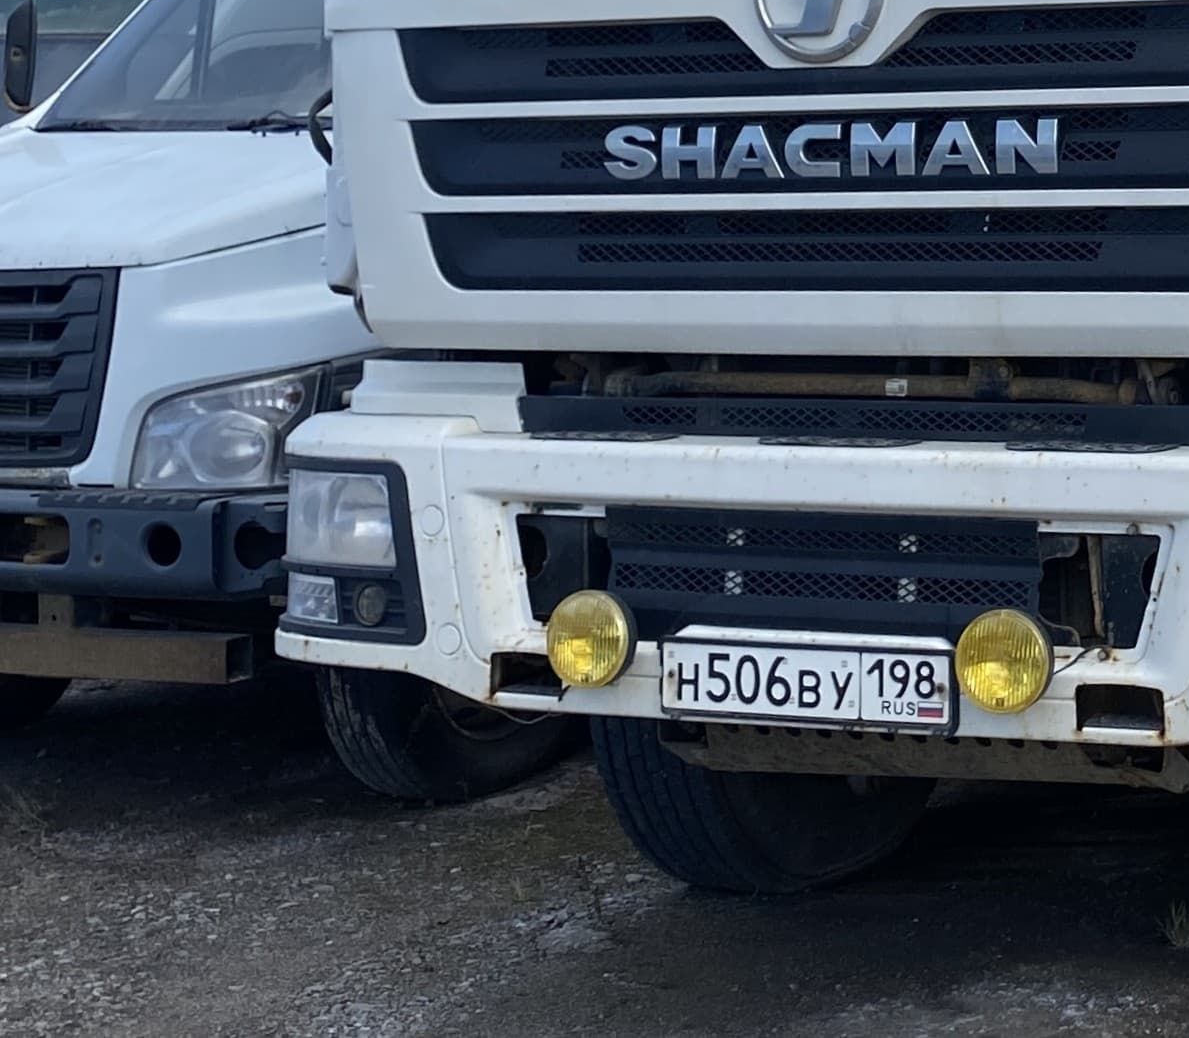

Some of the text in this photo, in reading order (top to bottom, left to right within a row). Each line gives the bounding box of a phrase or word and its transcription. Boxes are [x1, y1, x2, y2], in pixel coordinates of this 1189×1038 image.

[603, 117, 1060, 181] SHACMAN
[866, 658, 936, 699] 198
[881, 700, 916, 715] RUS
